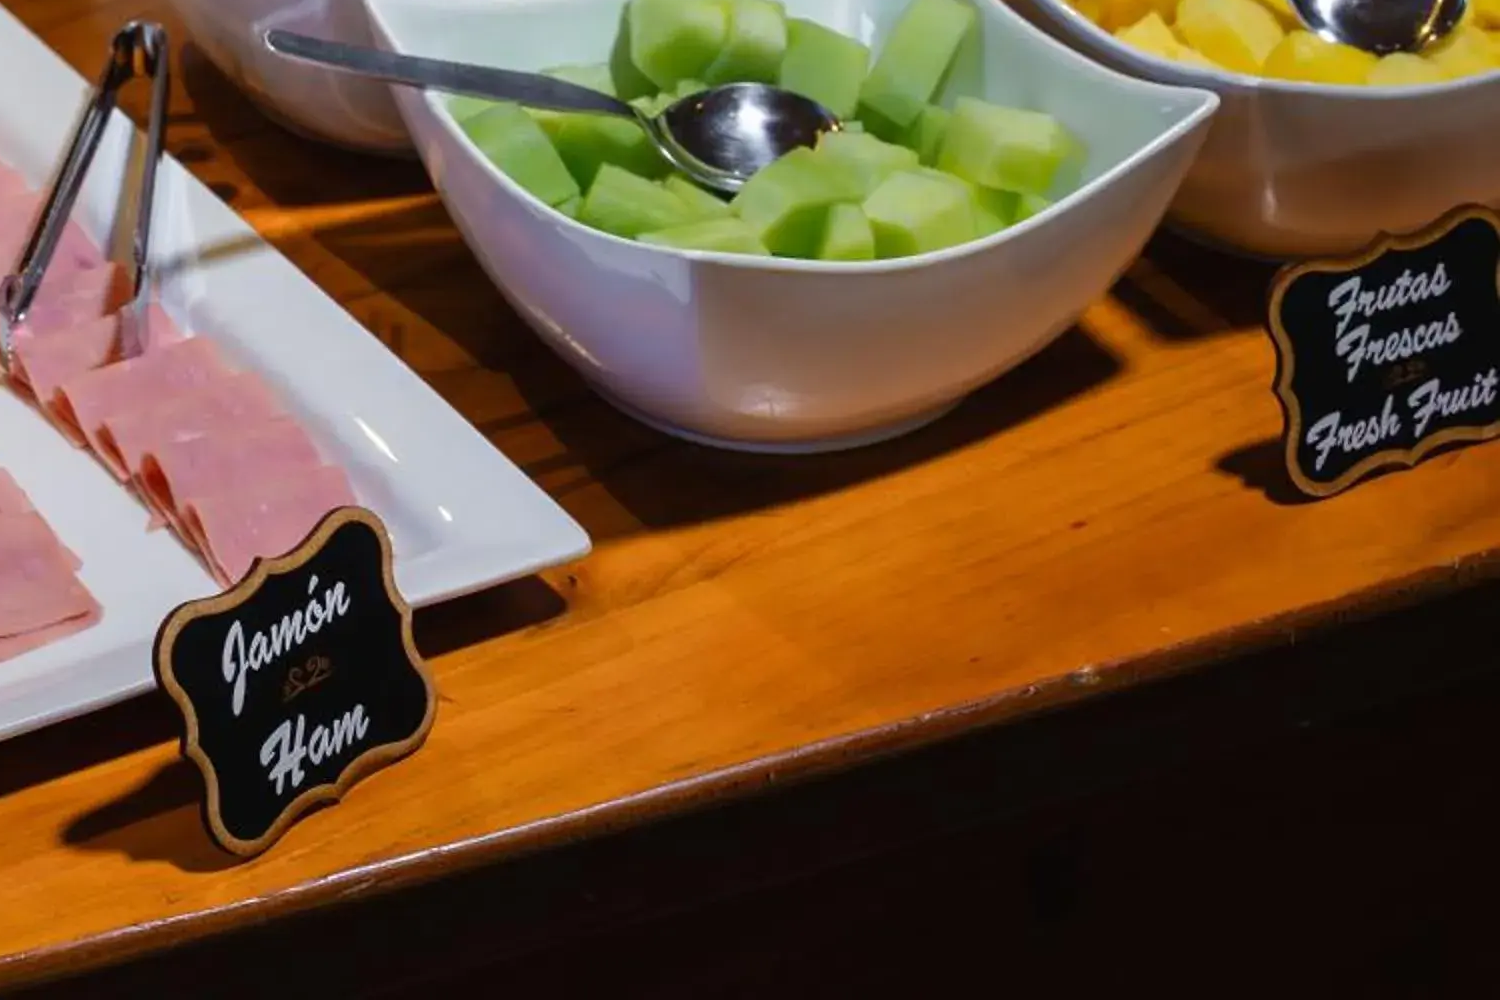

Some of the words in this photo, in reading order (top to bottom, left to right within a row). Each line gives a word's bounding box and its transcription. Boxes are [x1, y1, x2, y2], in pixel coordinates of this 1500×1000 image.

[1328, 262, 1451, 339] Frutas
[1336, 312, 1463, 383] Frescas
[1306, 395, 1401, 471] Fresh
[1407, 368, 1499, 438] Fruit
[222, 575, 350, 716] Jamón
[259, 704, 369, 795] Ham
